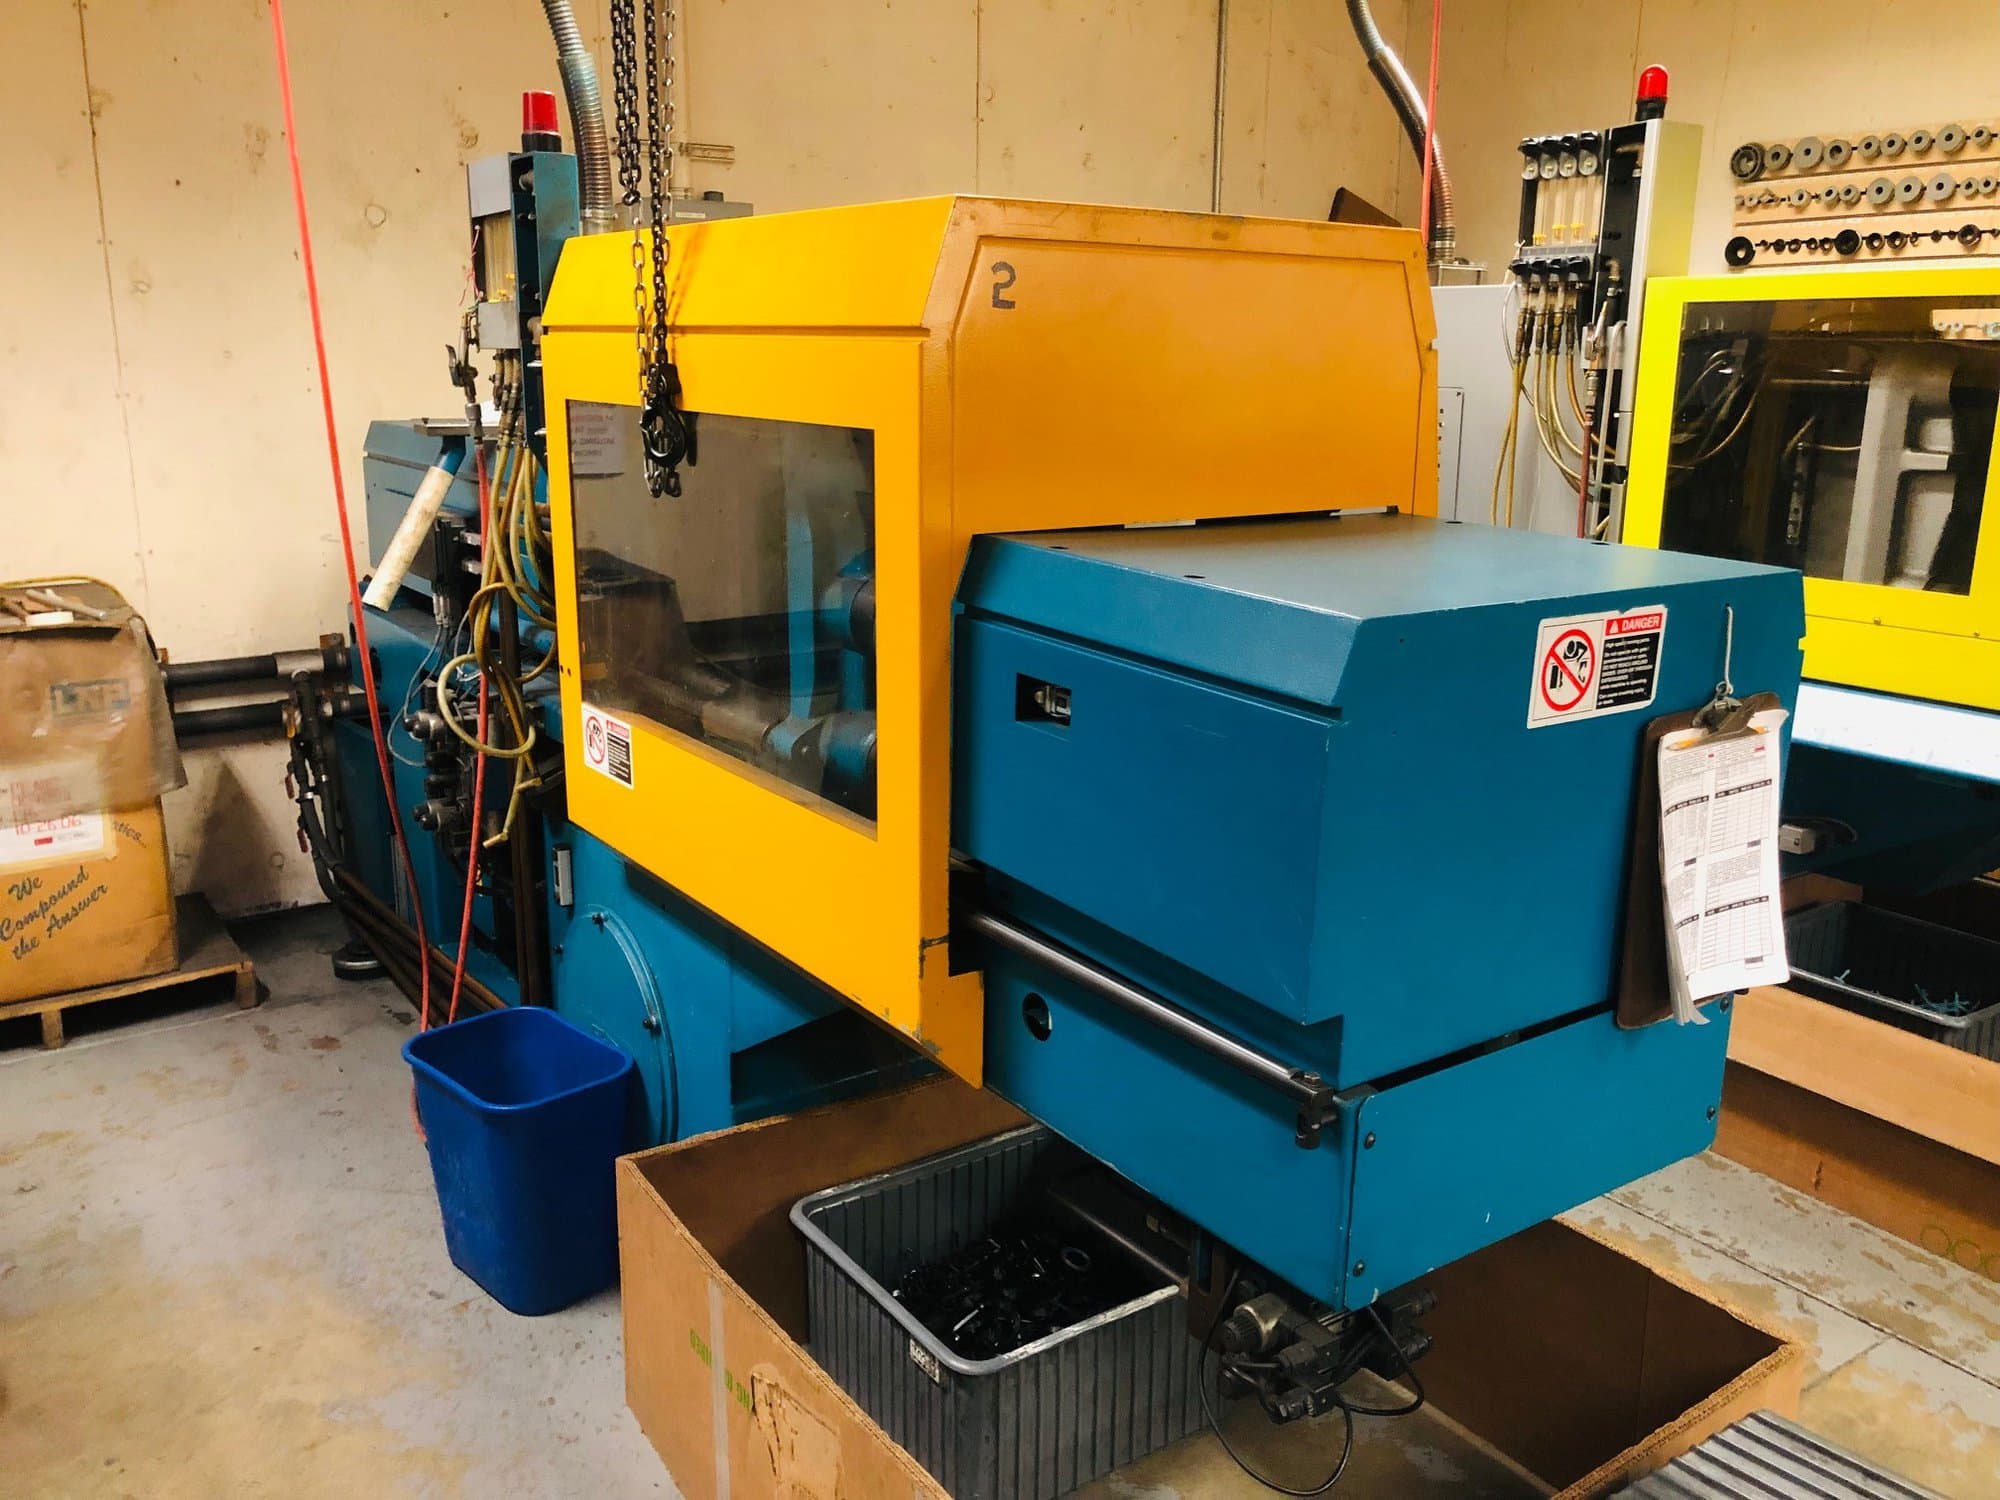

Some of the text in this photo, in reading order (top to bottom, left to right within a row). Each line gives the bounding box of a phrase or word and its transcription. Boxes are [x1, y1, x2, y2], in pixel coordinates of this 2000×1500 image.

[991, 261, 1016, 309] 2
[1621, 615, 1660, 631] DANGER
[0, 865, 90, 942] Compound
[8, 876, 43, 901] We
[12, 883, 108, 961] the Answer
